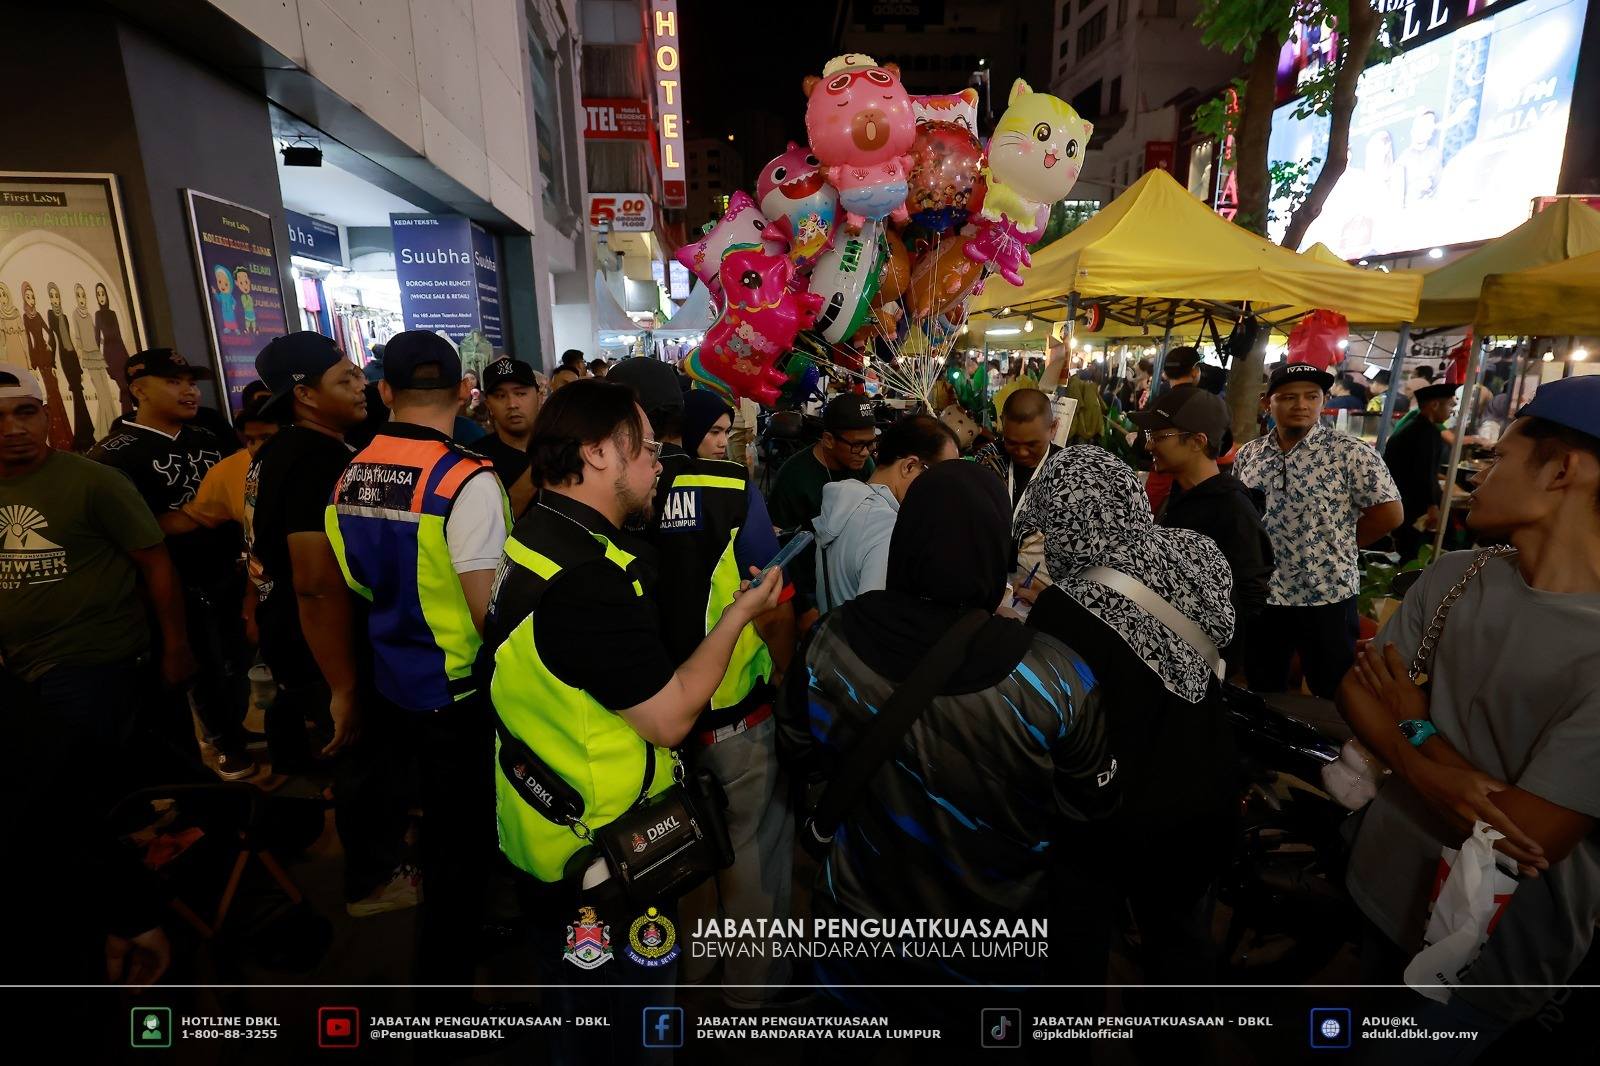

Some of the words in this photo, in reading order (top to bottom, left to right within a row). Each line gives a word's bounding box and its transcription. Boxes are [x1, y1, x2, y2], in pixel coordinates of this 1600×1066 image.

[845, 55, 856, 66] C
[655, 11, 680, 168] HOTEL
[3, 193, 30, 202] First
[33, 194, 60, 205] Lady
[222, 217, 236, 227] First
[401, 248, 471, 264] Suubha
[358, 487, 381, 501] DBKL
[672, 520, 696, 528] LUMPUR
[0, 556, 68, 573] HWEEK
[525, 775, 554, 808] DBKL
[647, 815, 680, 842] DBKL
